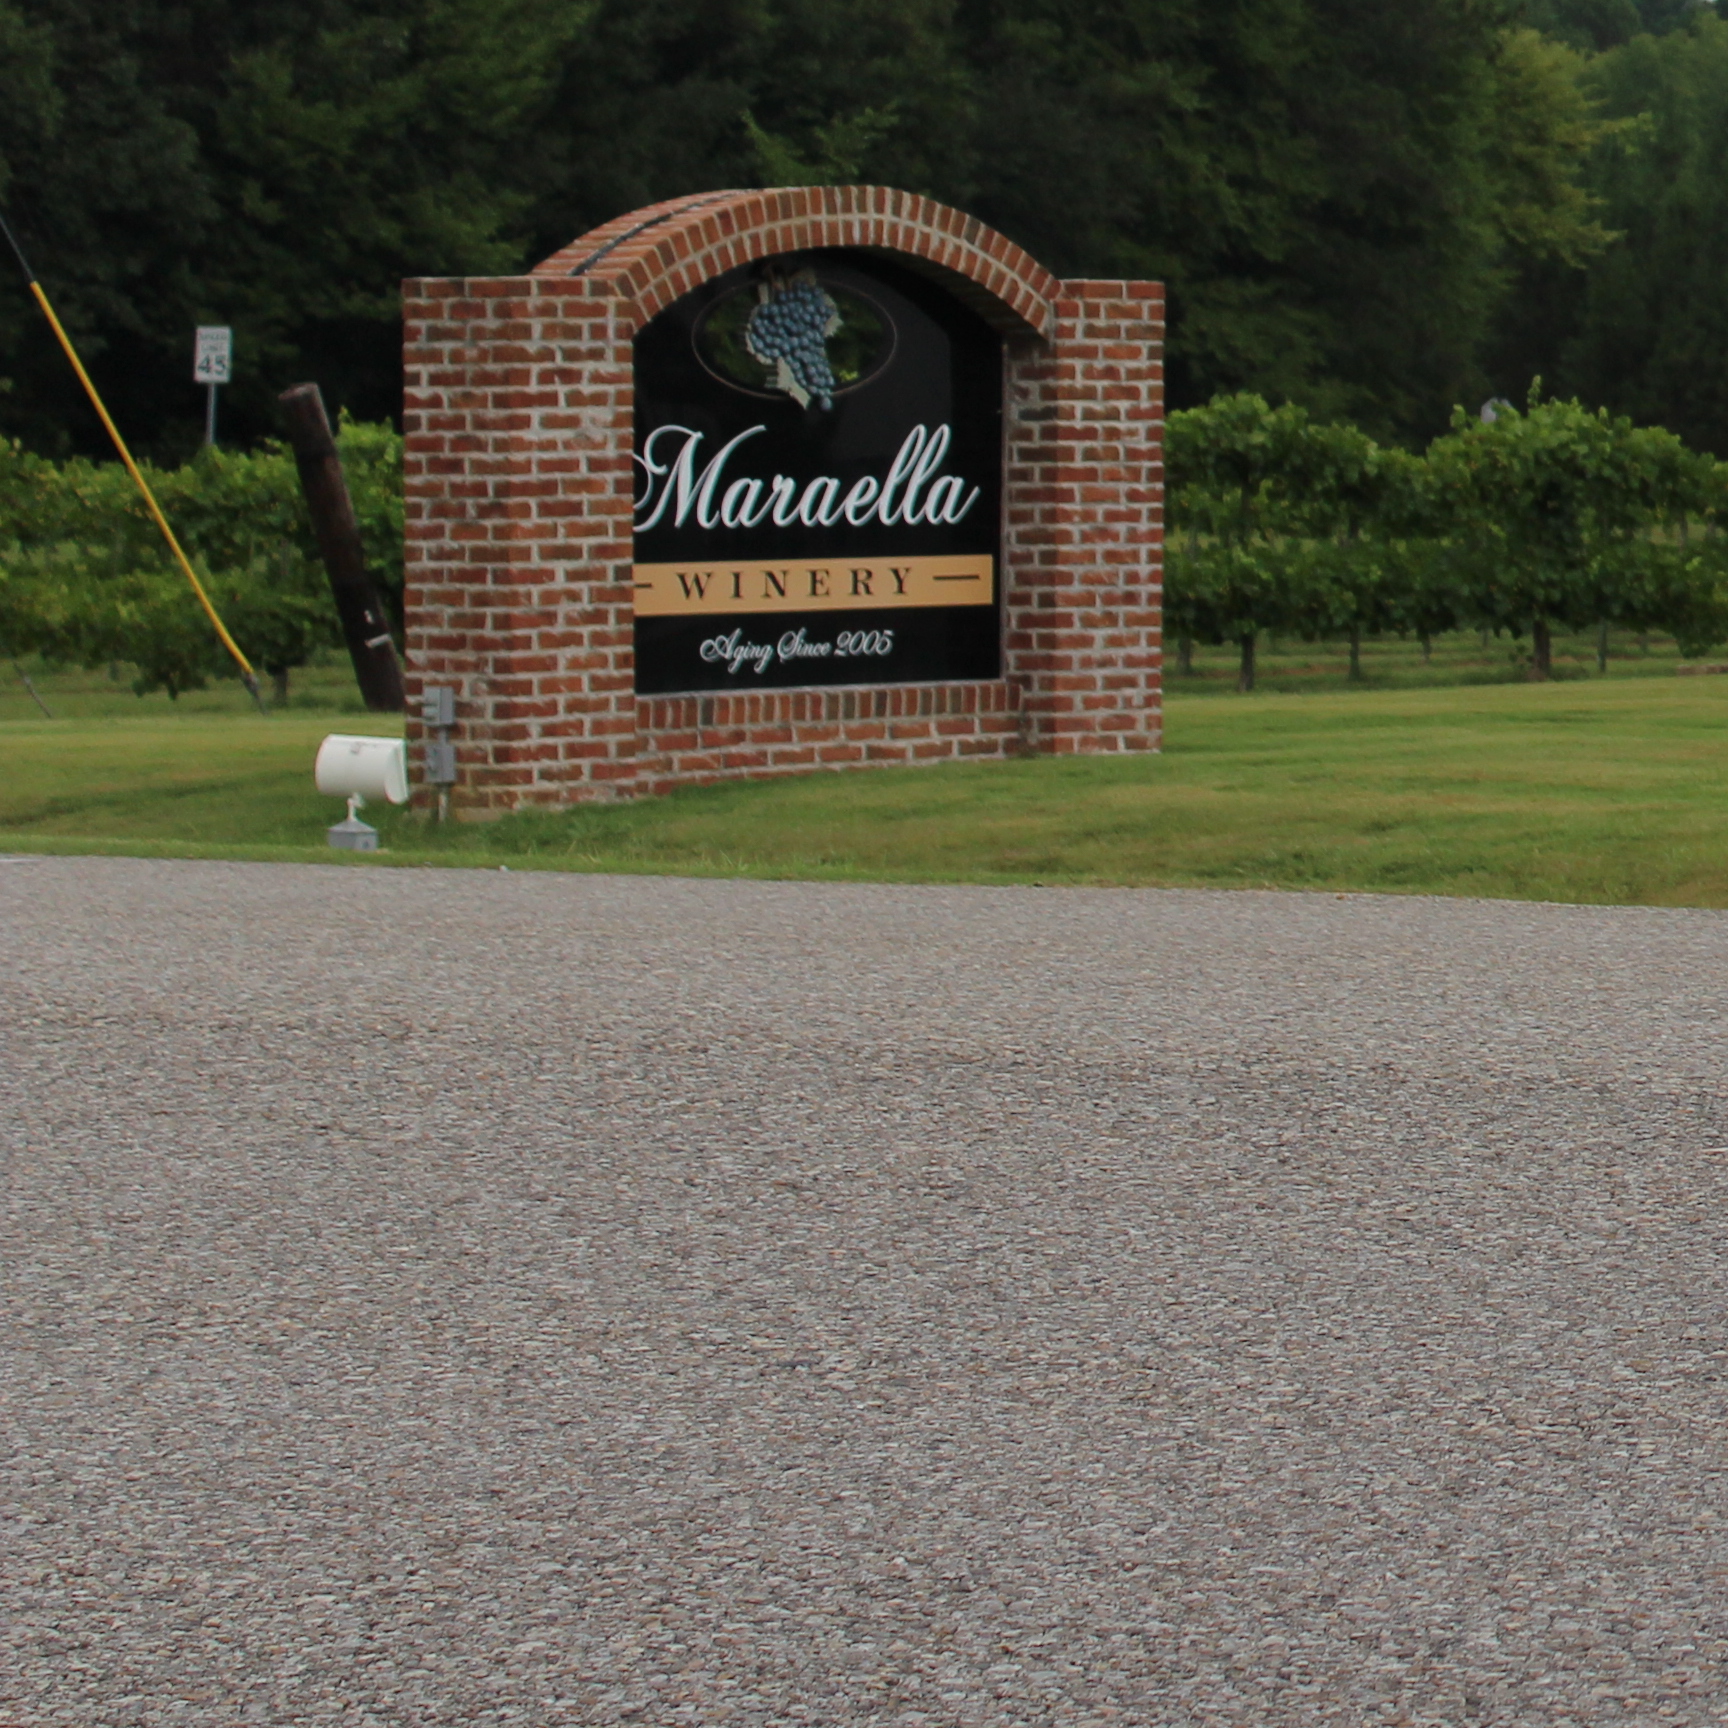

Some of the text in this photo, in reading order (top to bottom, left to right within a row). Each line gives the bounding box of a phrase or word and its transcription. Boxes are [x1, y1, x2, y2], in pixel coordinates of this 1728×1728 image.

[198, 354, 226, 376] 45
[633, 424, 981, 533] Maraella
[676, 567, 911, 600] WINERY
[700, 627, 894, 674] Aging Since 2005
